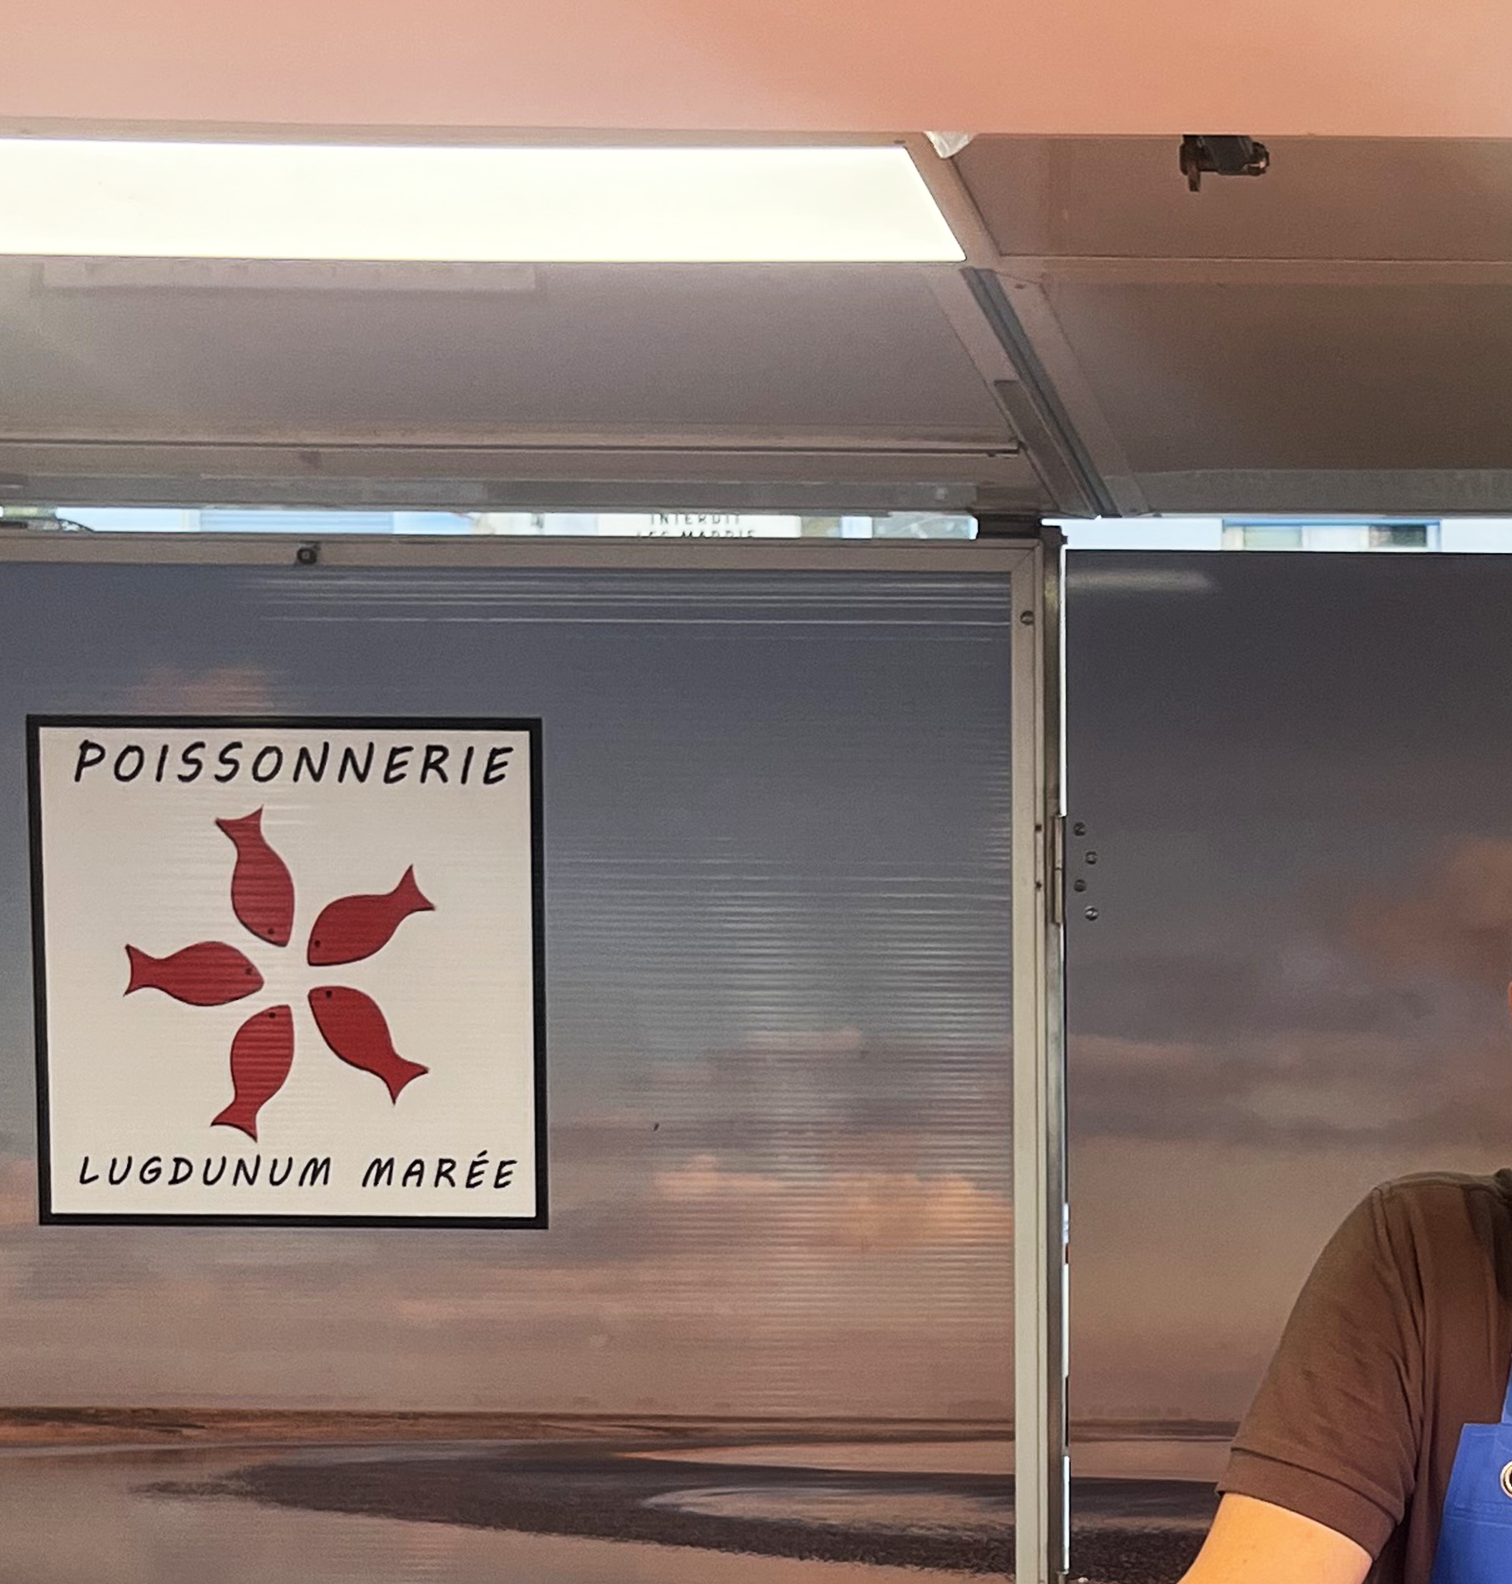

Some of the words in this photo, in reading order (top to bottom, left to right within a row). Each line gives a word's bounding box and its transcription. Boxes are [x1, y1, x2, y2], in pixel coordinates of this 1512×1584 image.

[74, 739, 515, 786] POISSONNERIE
[79, 1153, 333, 1187] LUGDUNUM
[361, 1149, 518, 1189] MARÉE
